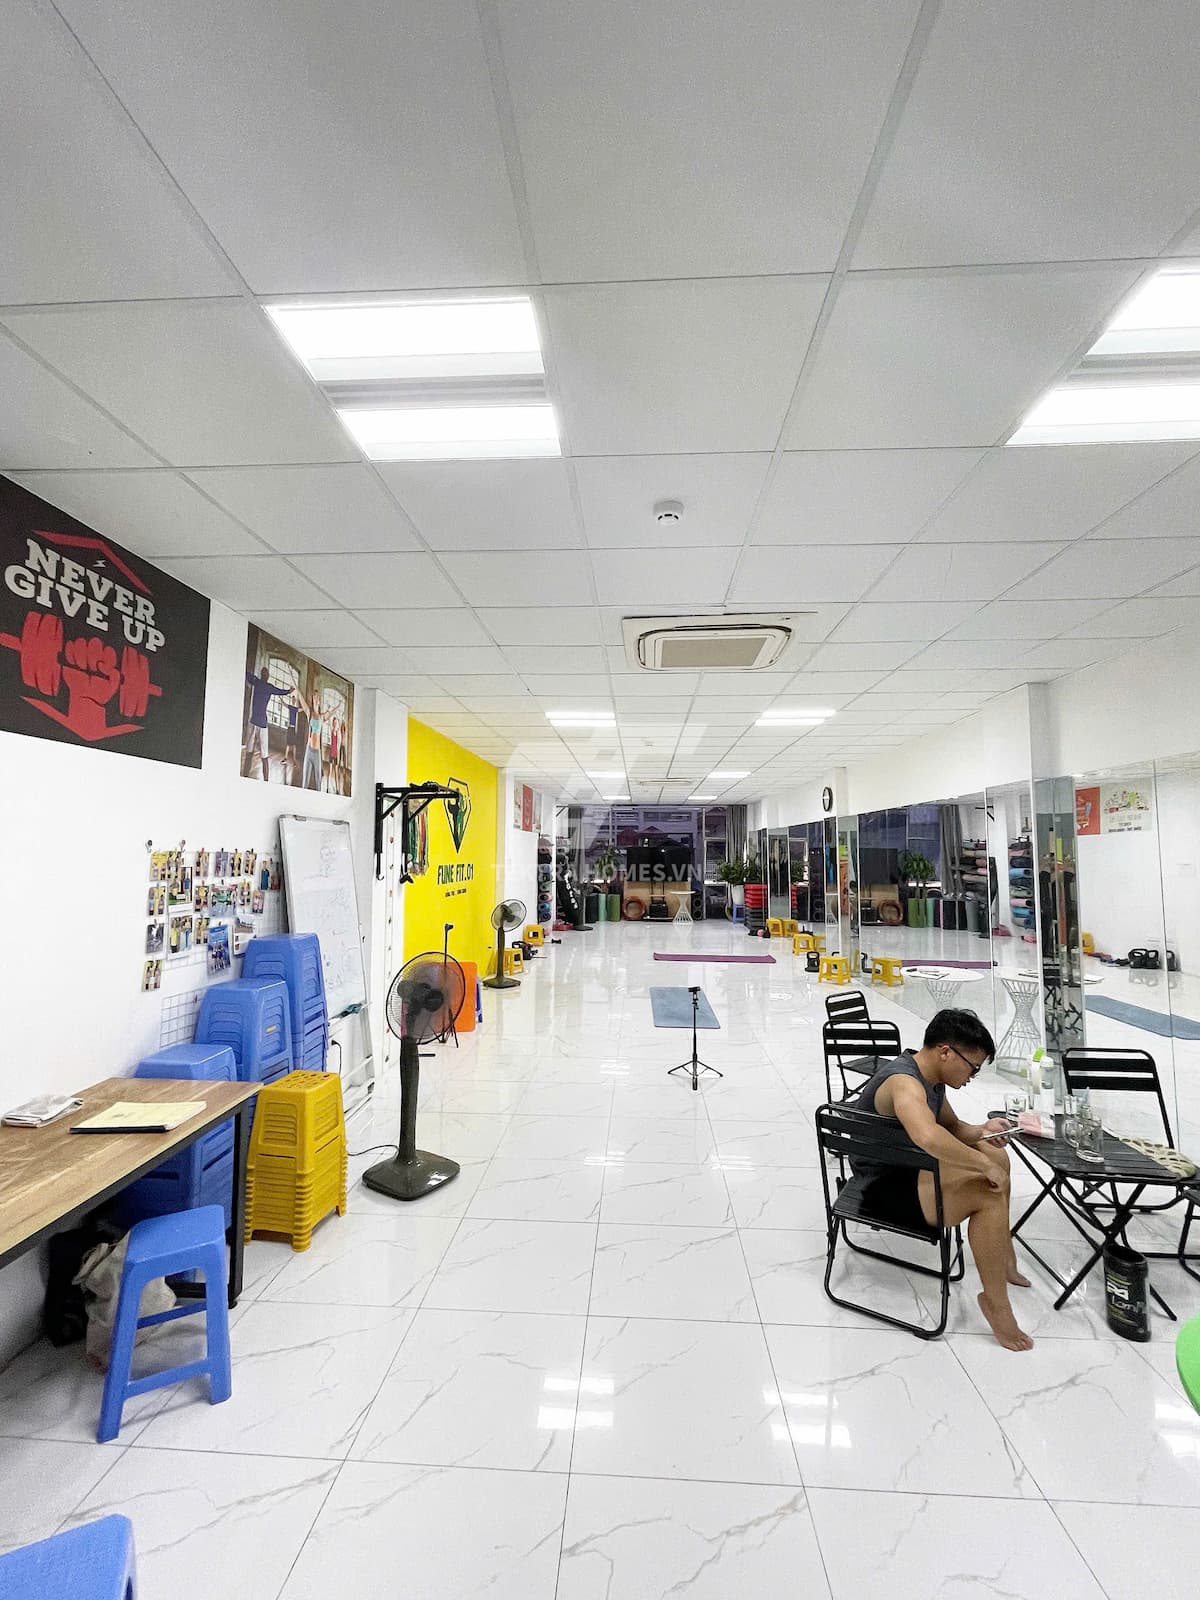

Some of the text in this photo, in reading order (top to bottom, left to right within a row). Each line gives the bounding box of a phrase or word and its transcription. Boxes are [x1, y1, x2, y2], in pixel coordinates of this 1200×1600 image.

[4, 564, 166, 652] GIVE UP
[25, 538, 156, 626] NEVER
